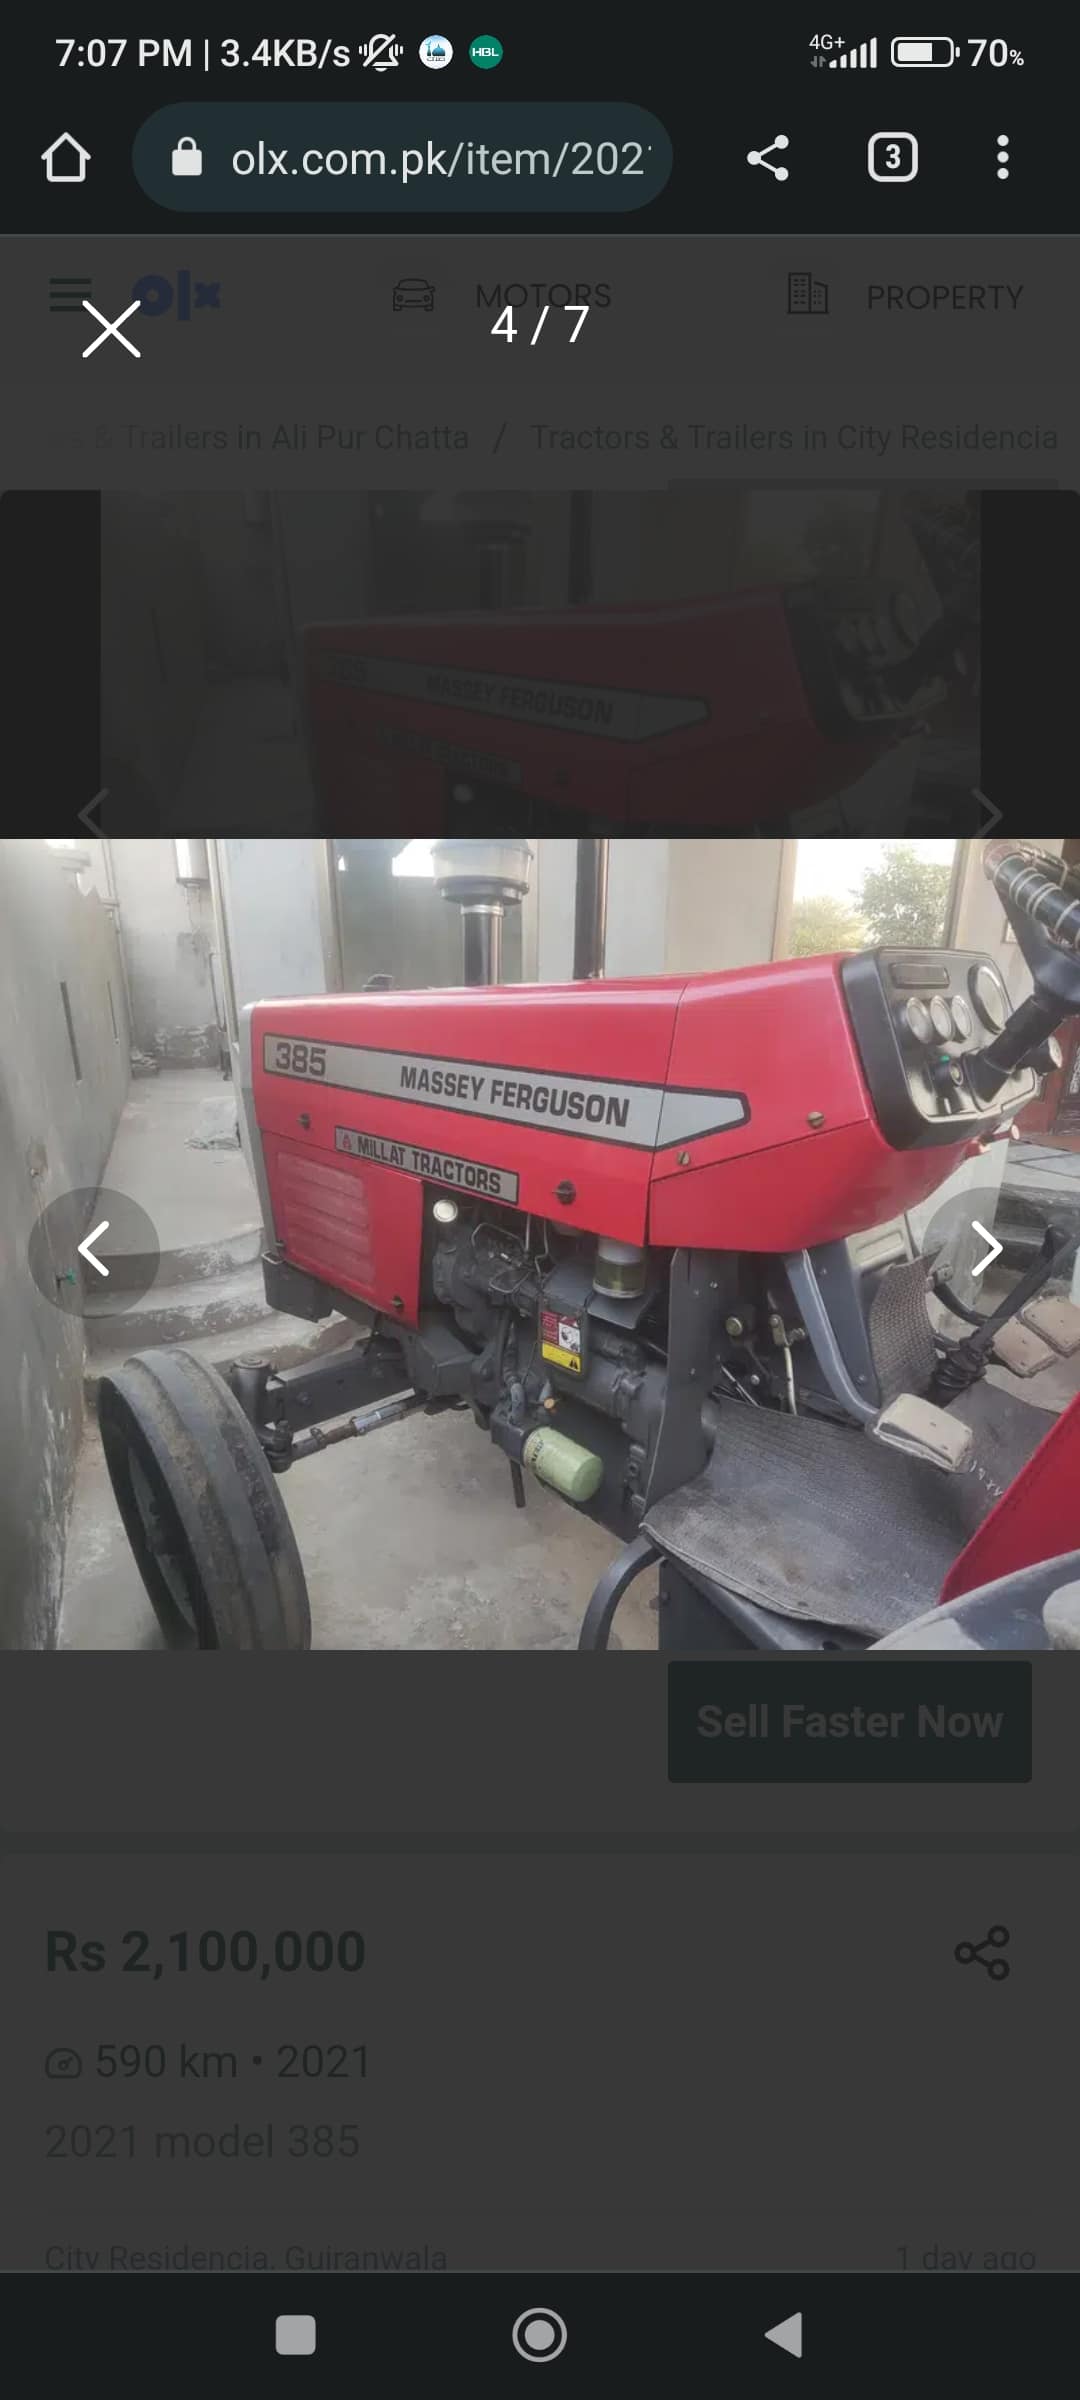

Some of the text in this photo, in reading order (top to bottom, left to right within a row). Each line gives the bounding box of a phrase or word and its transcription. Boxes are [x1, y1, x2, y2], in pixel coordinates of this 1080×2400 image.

[56, 38, 128, 68] 7:07
[138, 38, 192, 67] PM
[220, 38, 351, 70] 3.4KB/s
[472, 47, 499, 57] HBL
[809, 33, 846, 51] 4G+
[232, 140, 652, 184] olx.com.pk/item/202
[885, 143, 901, 170] 3
[131, 269, 222, 321] olx
[476, 283, 612, 310] MOTORS
[868, 284, 1025, 311] PROPERTY
[490, 306, 518, 343] 4
[564, 306, 590, 343] 7
[119, 424, 228, 449] Trailers
[238, 424, 262, 449] in
[272, 424, 307, 449] Ali
[318, 424, 367, 449] Pur
[375, 424, 469, 450] Chatta
[530, 424, 1058, 457] Tractors & Trailers in City Residencia
[275, 1041, 327, 1077] 385
[400, 1065, 631, 1128] MASSEY FERGUSON
[412, 1150, 502, 1194] TRACTORS
[696, 1703, 1005, 1738] Sell Faster Now
[46, 1930, 365, 1981] Rs 2,100,000
[96, 2044, 166, 2078] 590
[180, 2043, 238, 2079] km
[277, 2044, 369, 2078] 2021
[45, 2123, 360, 2159] 2021 model 385
[896, 2246, 907, 2270] 1
